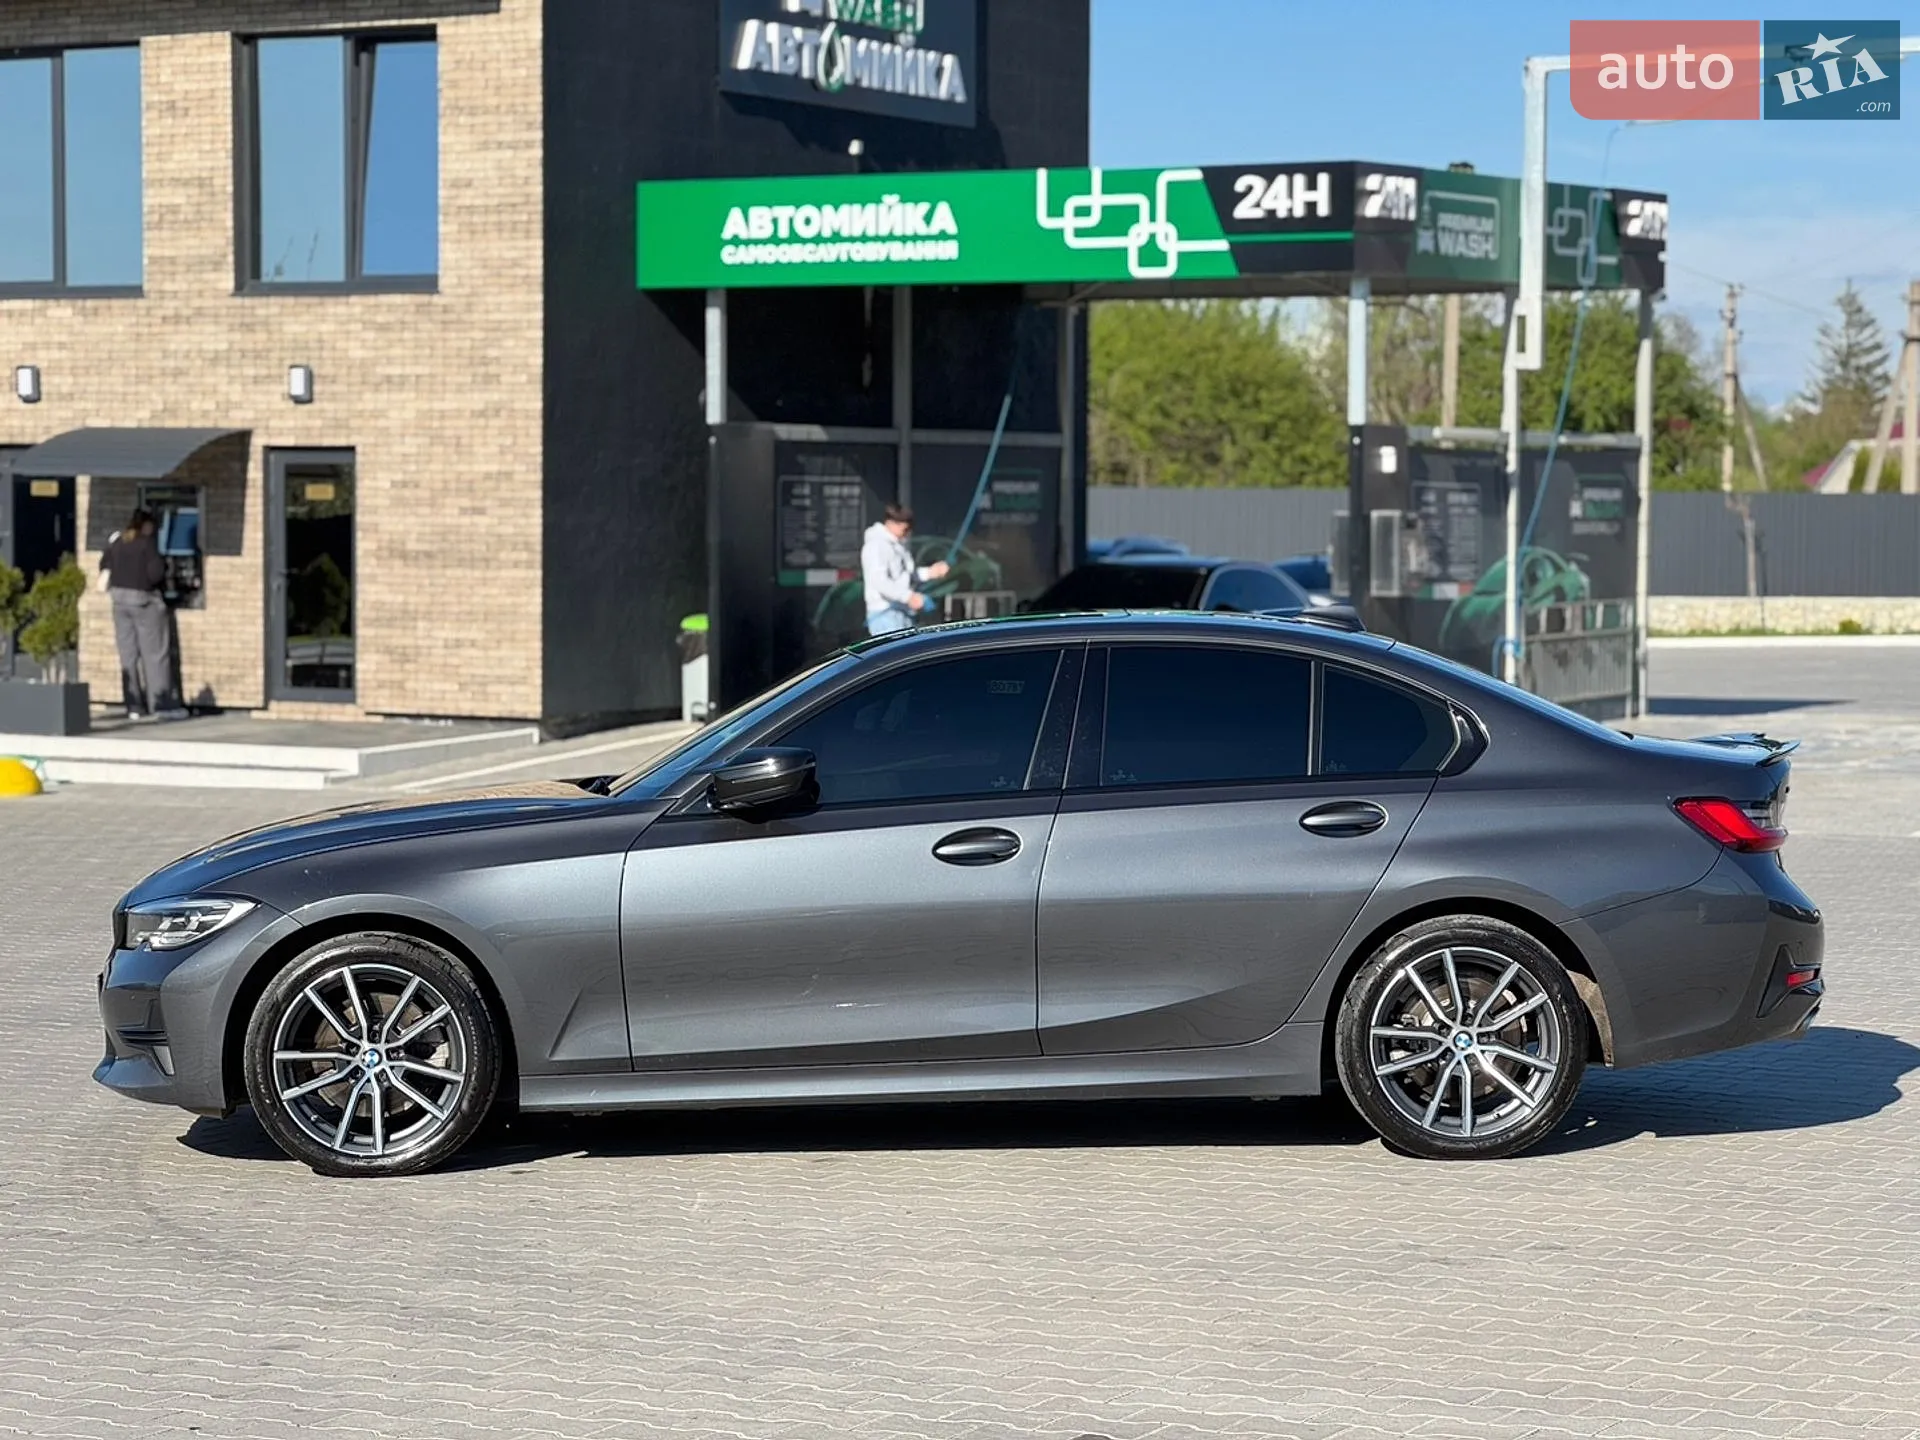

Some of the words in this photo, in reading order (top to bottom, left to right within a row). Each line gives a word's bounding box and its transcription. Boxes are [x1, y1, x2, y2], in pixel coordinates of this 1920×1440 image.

[720, 193, 959, 240] АВТОМИЙКА
[1232, 172, 1332, 220] 24H
[1437, 229, 1494, 259] WASH
